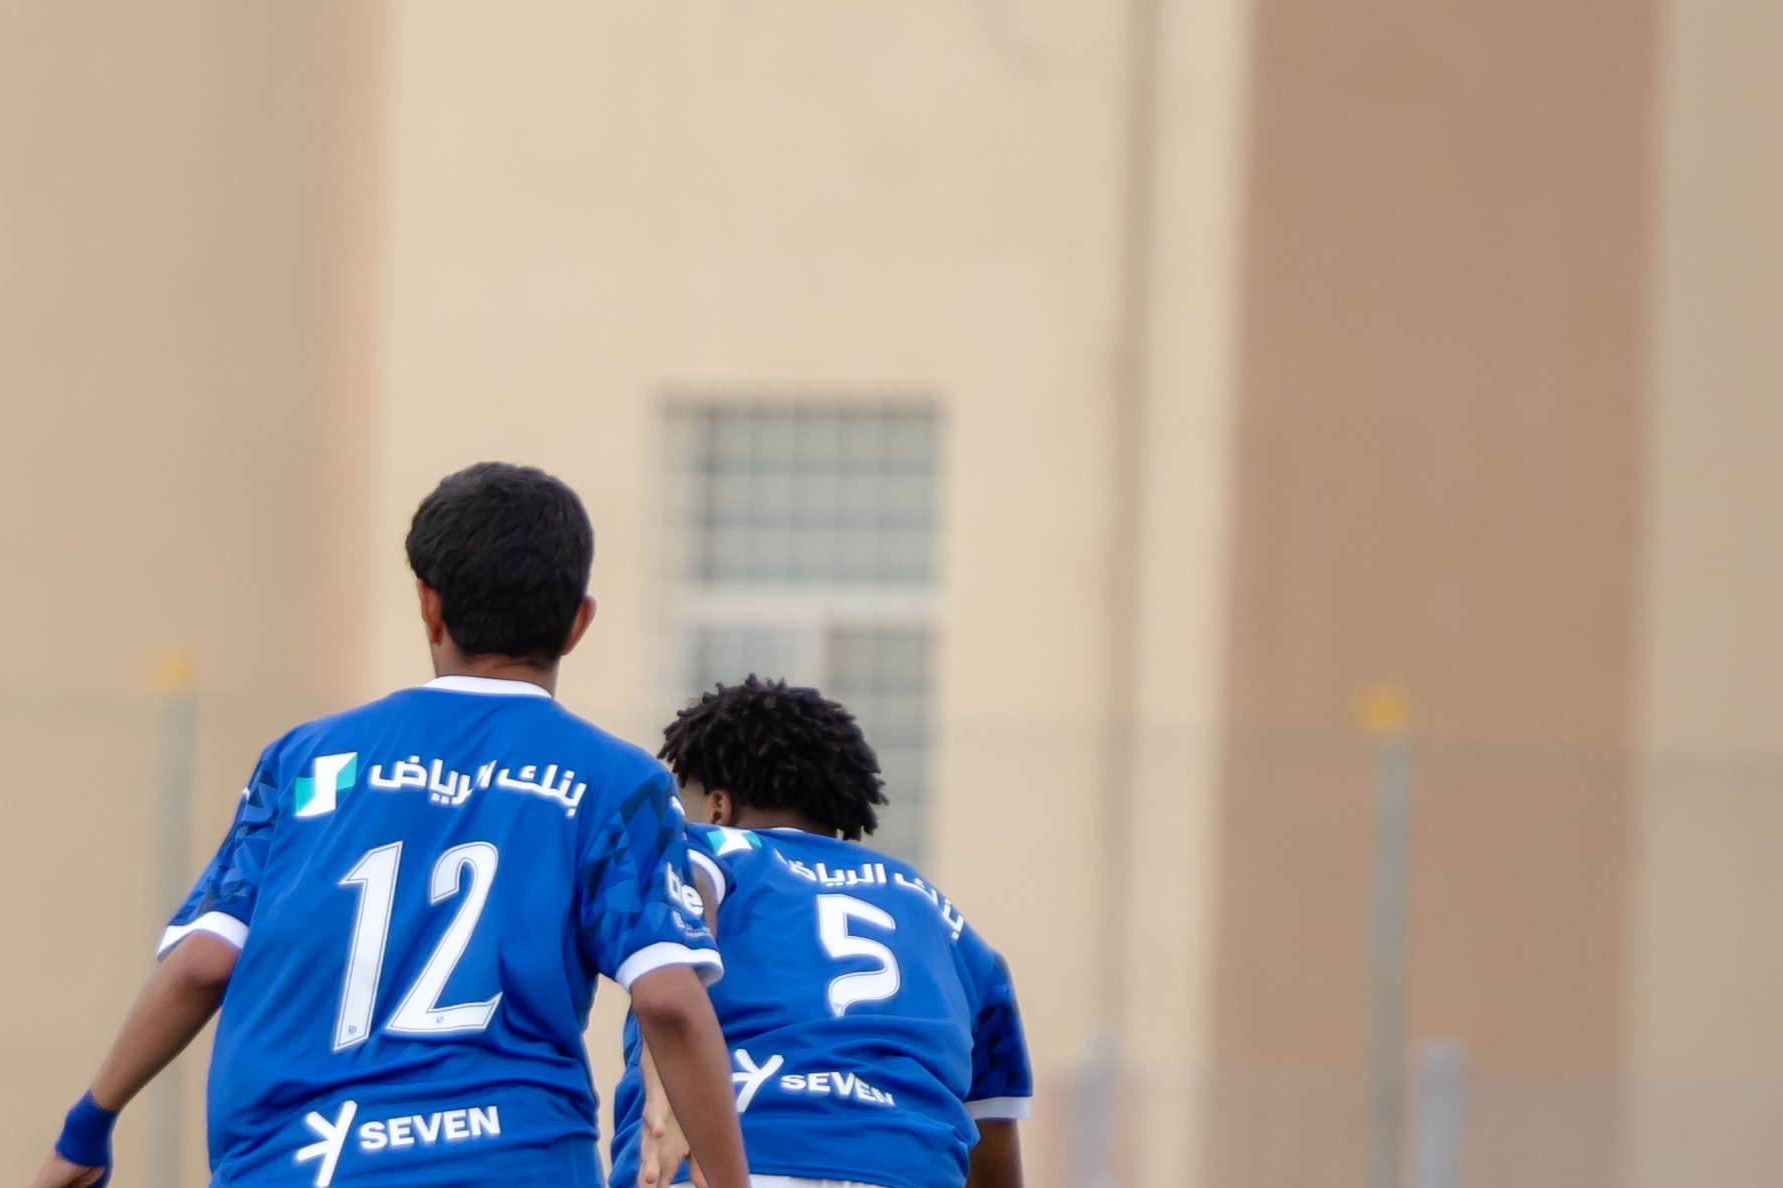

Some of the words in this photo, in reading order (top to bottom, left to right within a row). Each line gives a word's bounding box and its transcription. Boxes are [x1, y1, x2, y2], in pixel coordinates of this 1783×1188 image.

[497, 763, 587, 818] بنك
[333, 838, 504, 1051] 12
[816, 893, 901, 1018] 5
[779, 1071, 897, 1108] SEVEN
[359, 1105, 502, 1151] SEVEN
